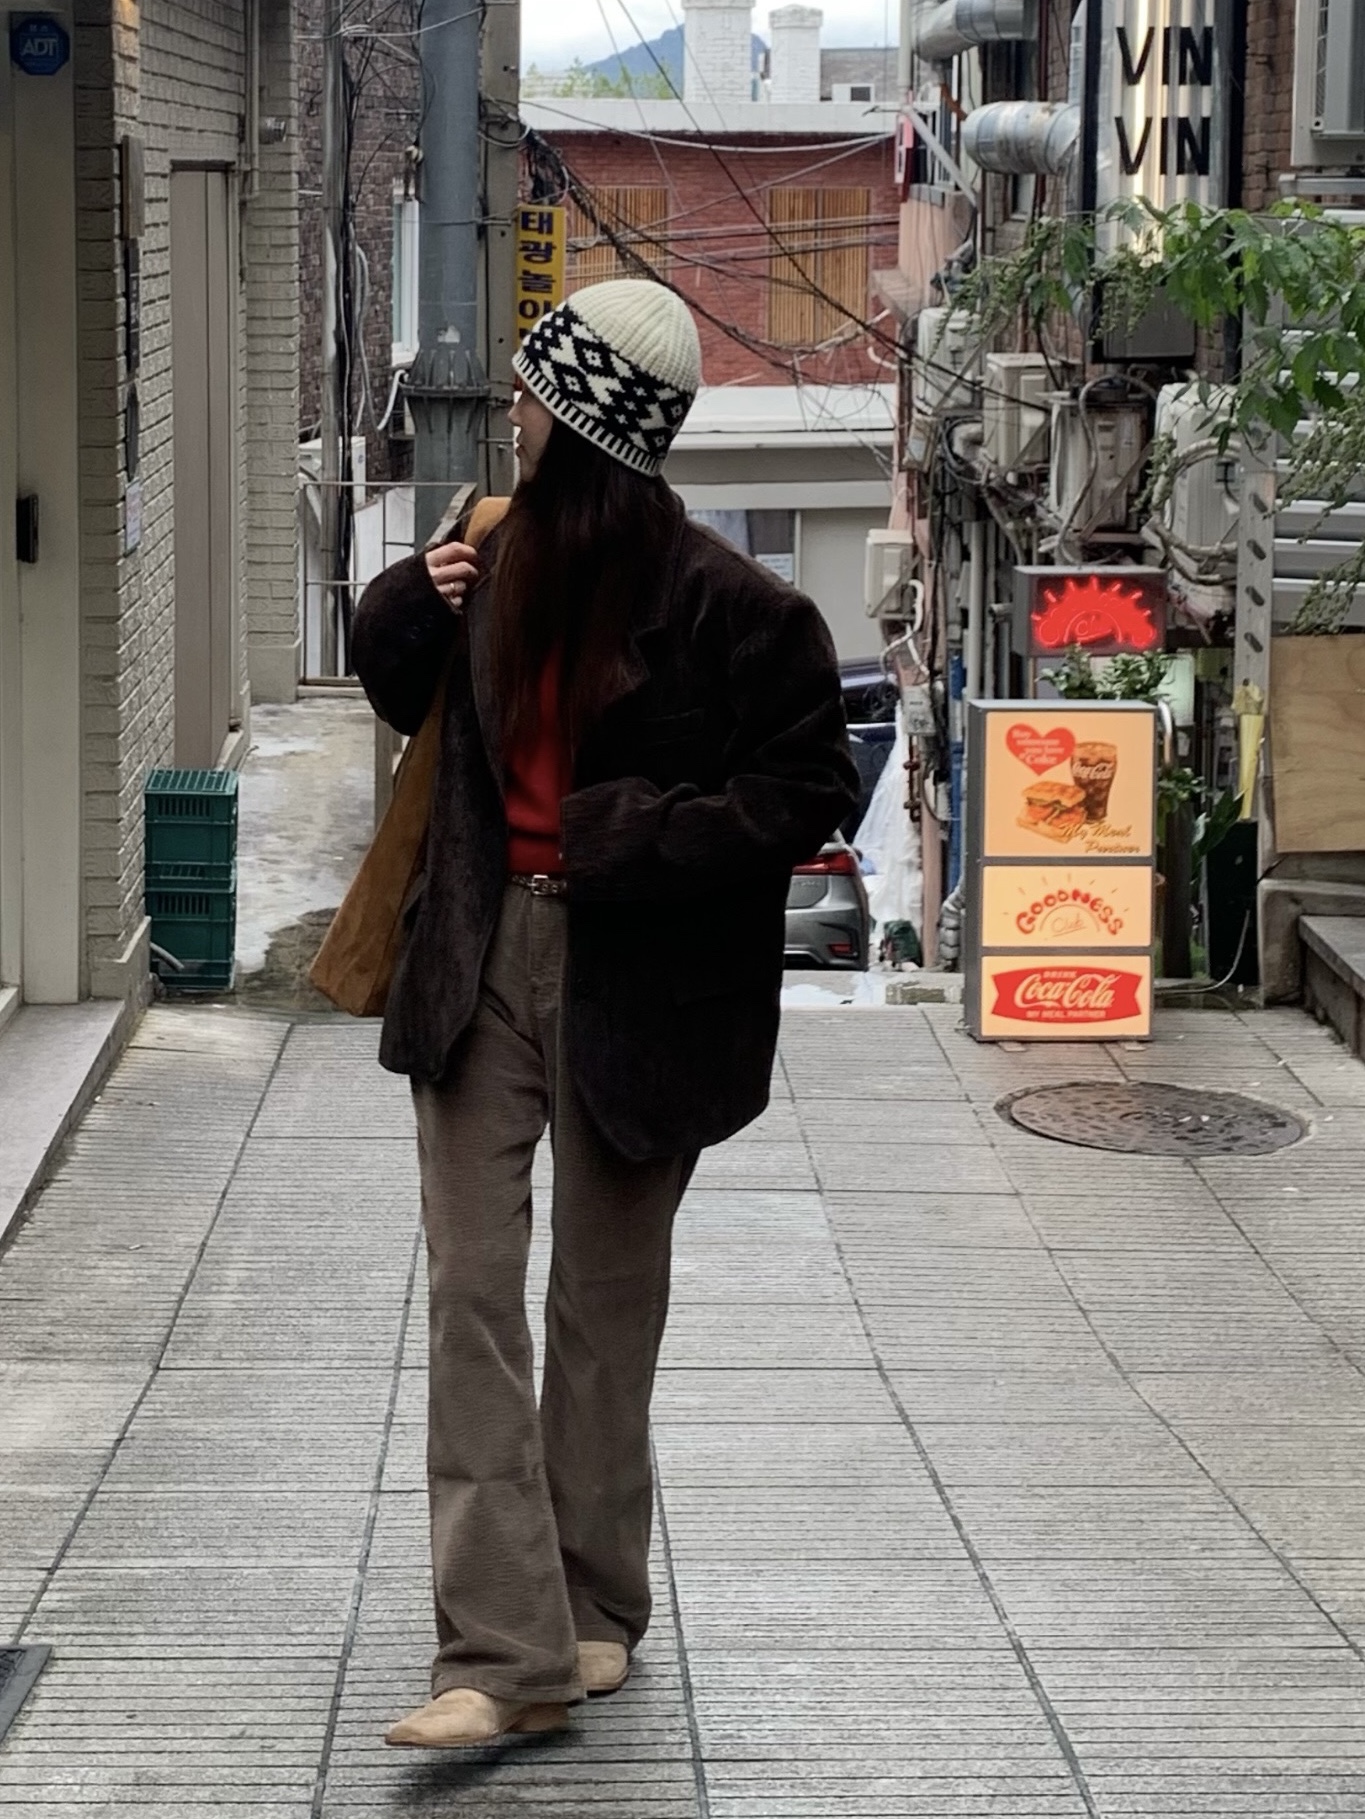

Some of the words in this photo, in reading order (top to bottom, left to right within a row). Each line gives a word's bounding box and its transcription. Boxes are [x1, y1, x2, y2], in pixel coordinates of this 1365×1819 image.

[20, 38, 58, 56] ADT
[1115, 26, 1214, 87] VIN
[1114, 116, 1212, 176] VIN
[518, 211, 557, 339] 태광놀이
[1016, 888, 1124, 936] GOODNESS
[1051, 912, 1085, 933] Club
[1014, 973, 1122, 1009] Coca-Cola
[1043, 970, 1077, 979] DRINK
